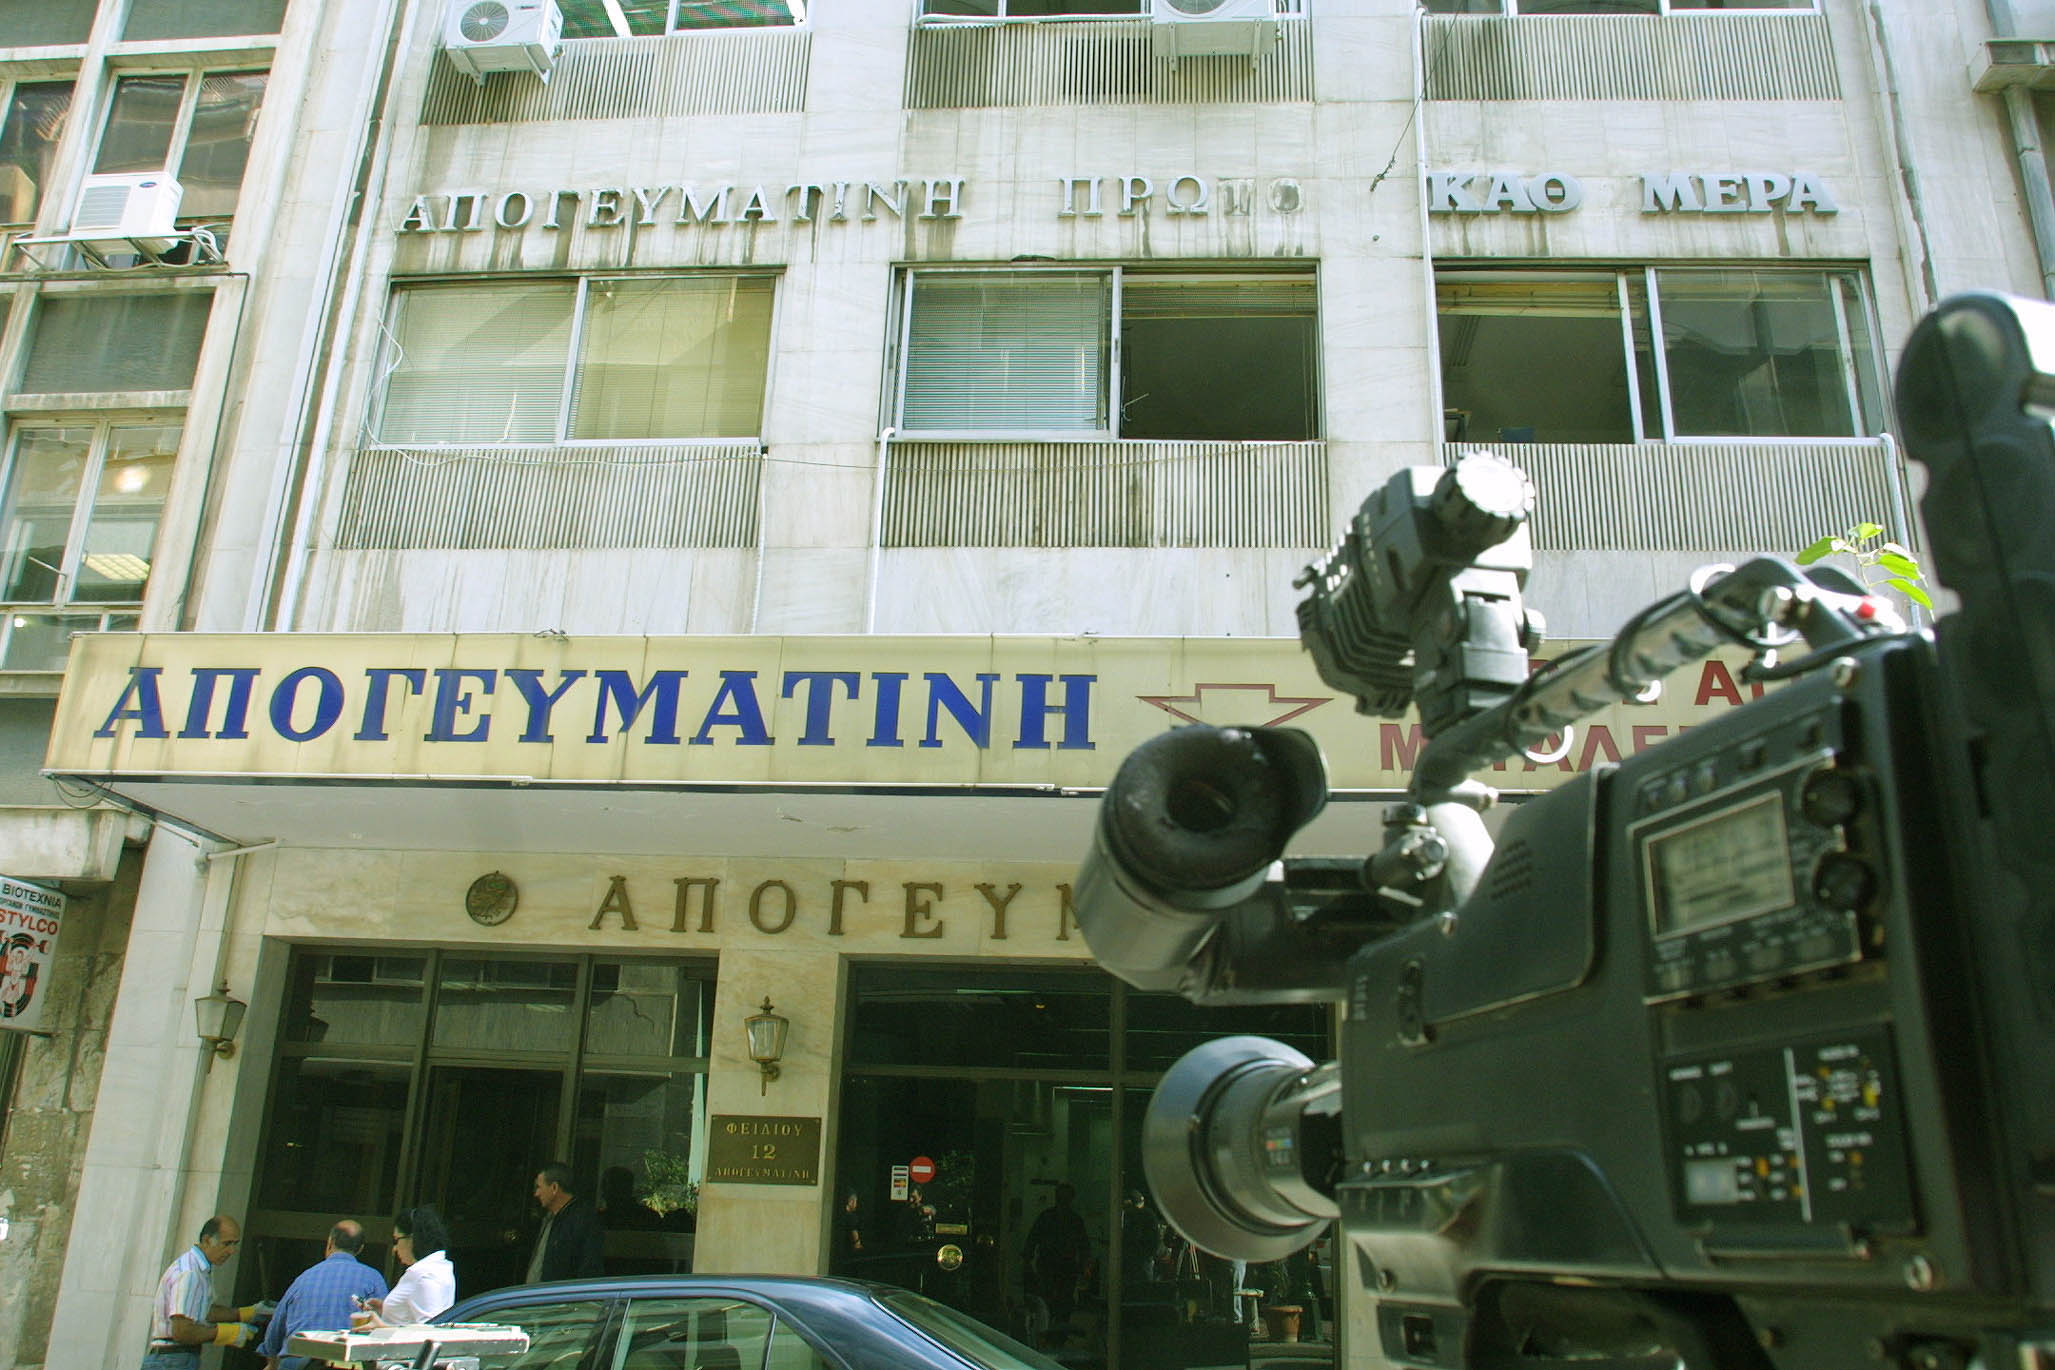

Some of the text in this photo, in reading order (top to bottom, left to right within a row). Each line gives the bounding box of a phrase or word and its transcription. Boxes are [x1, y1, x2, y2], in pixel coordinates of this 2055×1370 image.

[394, 172, 1839, 233] ΑΠΟΓΕΥΜΑΤΙΝΗ ΠΡΩΤΟ ΚΑΘ ΜΕΡΑ
[94, 667, 1098, 750] ΑΠΟΓΕΥΜΑΤΙΝΗ
[2, 884, 61, 908] ΒΙΟΤΕΧΝΙΑ
[0, 908, 58, 935] STYLCO
[726, 1122, 802, 1136] ΦΕΙΔΙΟΥ
[752, 1144, 777, 1160] 12
